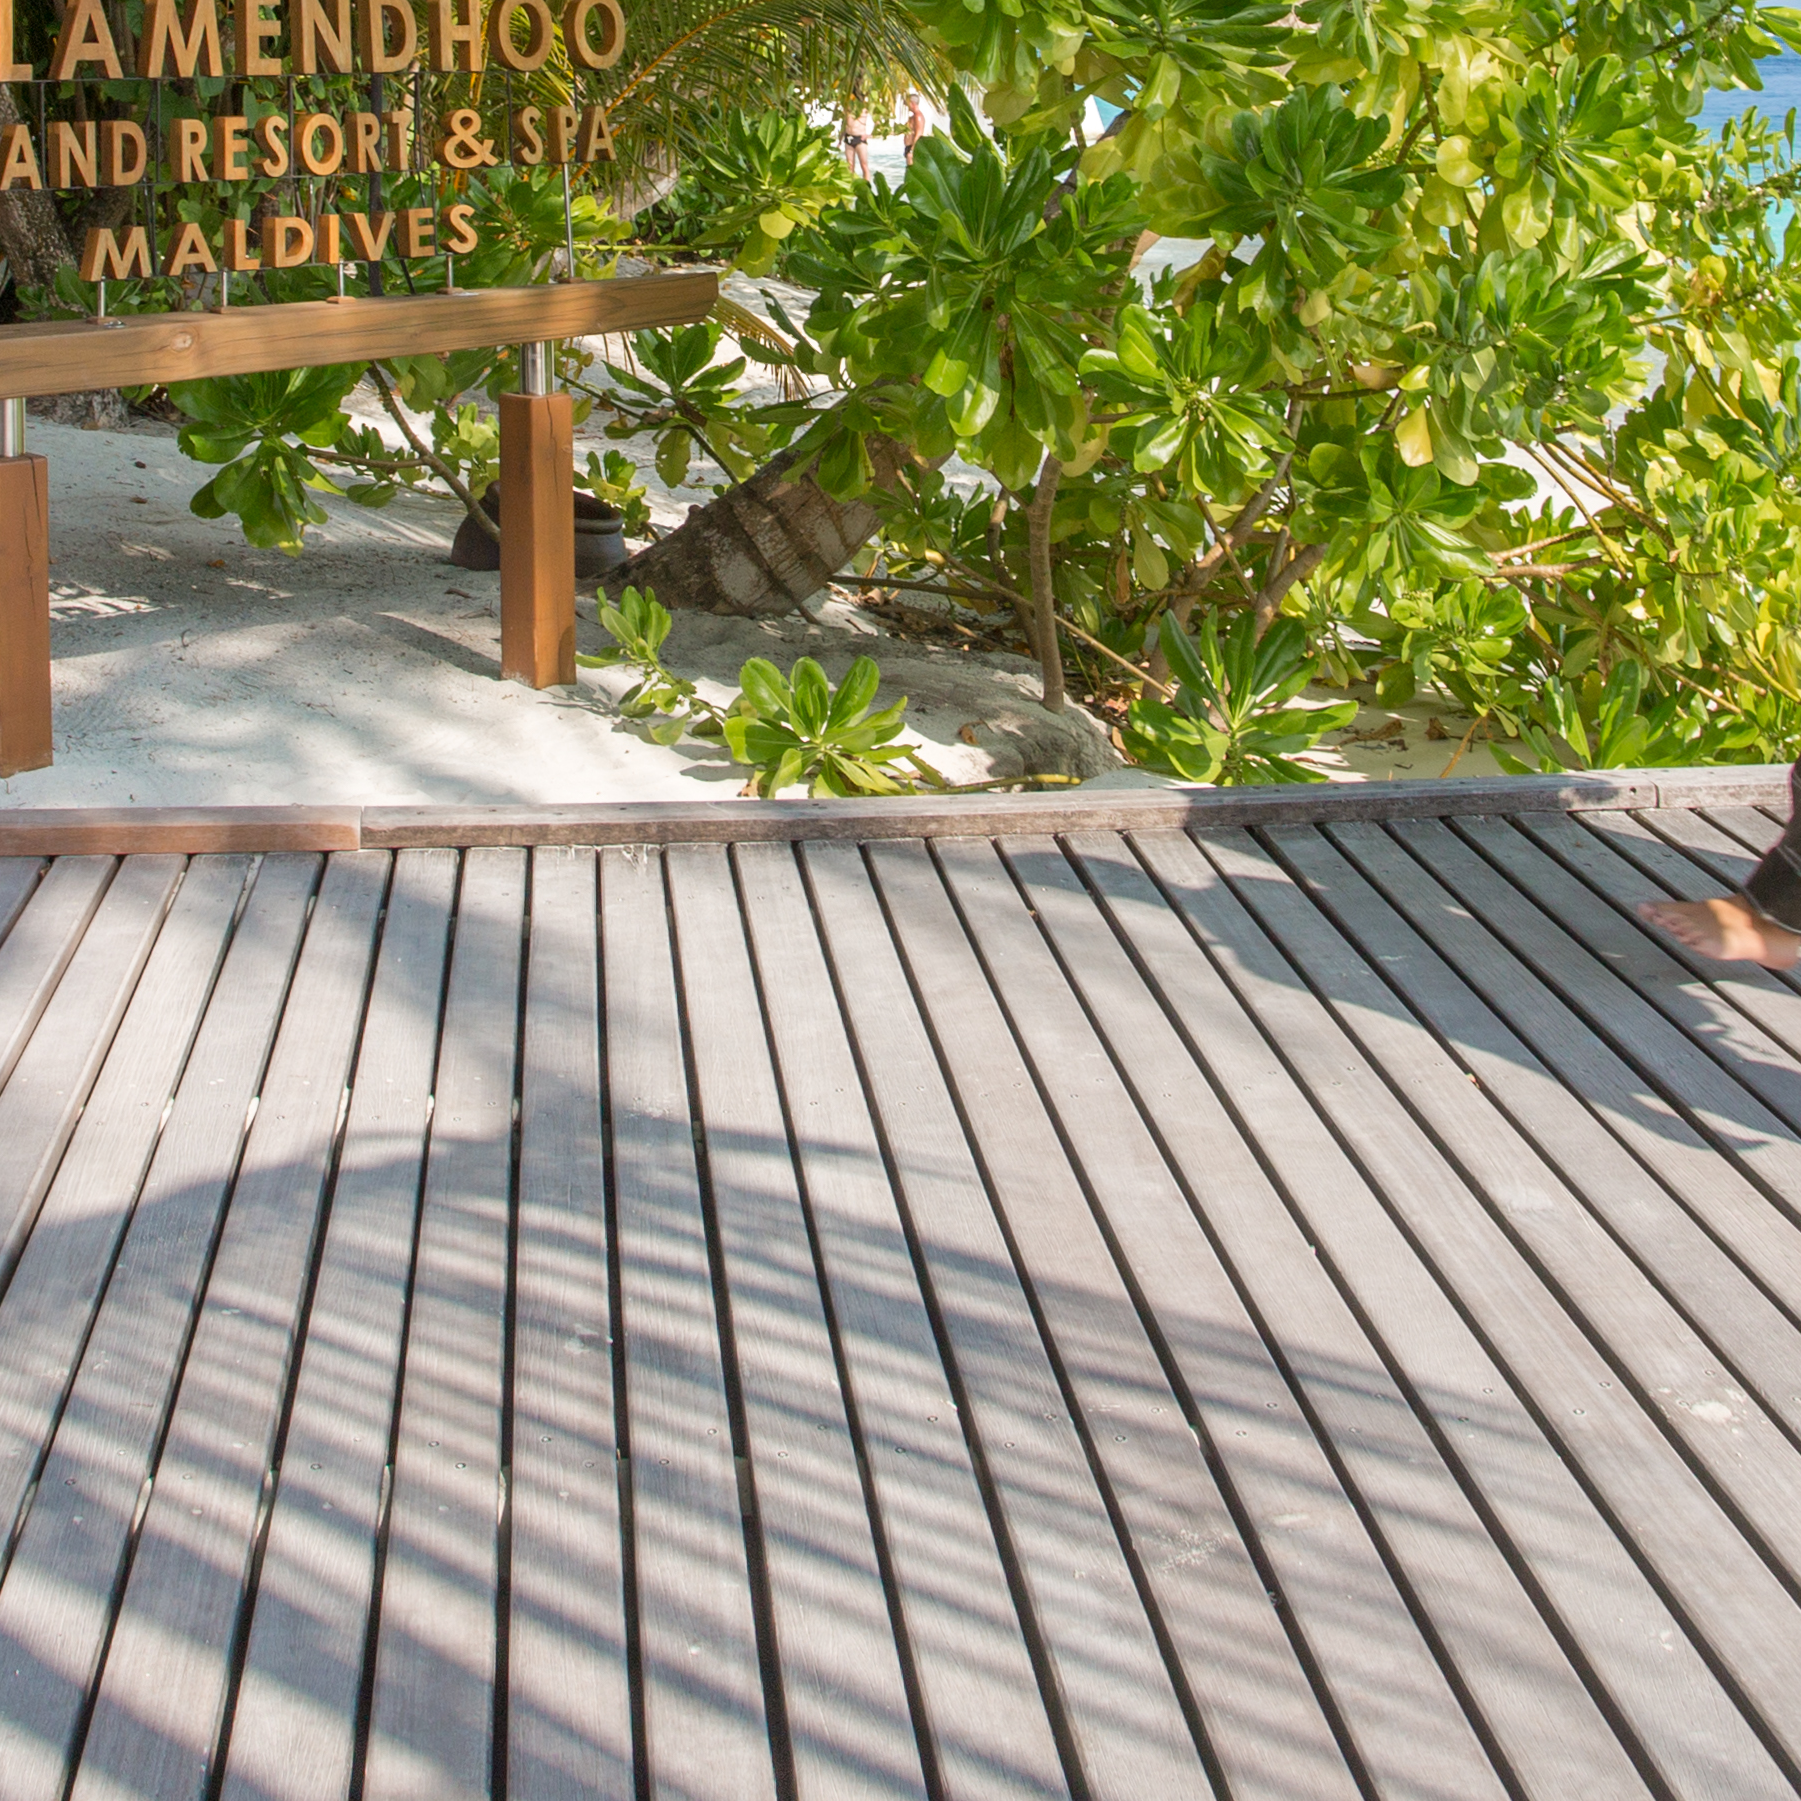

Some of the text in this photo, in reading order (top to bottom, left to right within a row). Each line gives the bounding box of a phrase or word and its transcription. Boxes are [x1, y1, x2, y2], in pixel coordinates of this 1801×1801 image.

[169, 110, 413, 183] RESORT
[433, 108, 498, 169] &
[511, 105, 617, 166] SPA
[79, 203, 479, 282] MALDIVES
